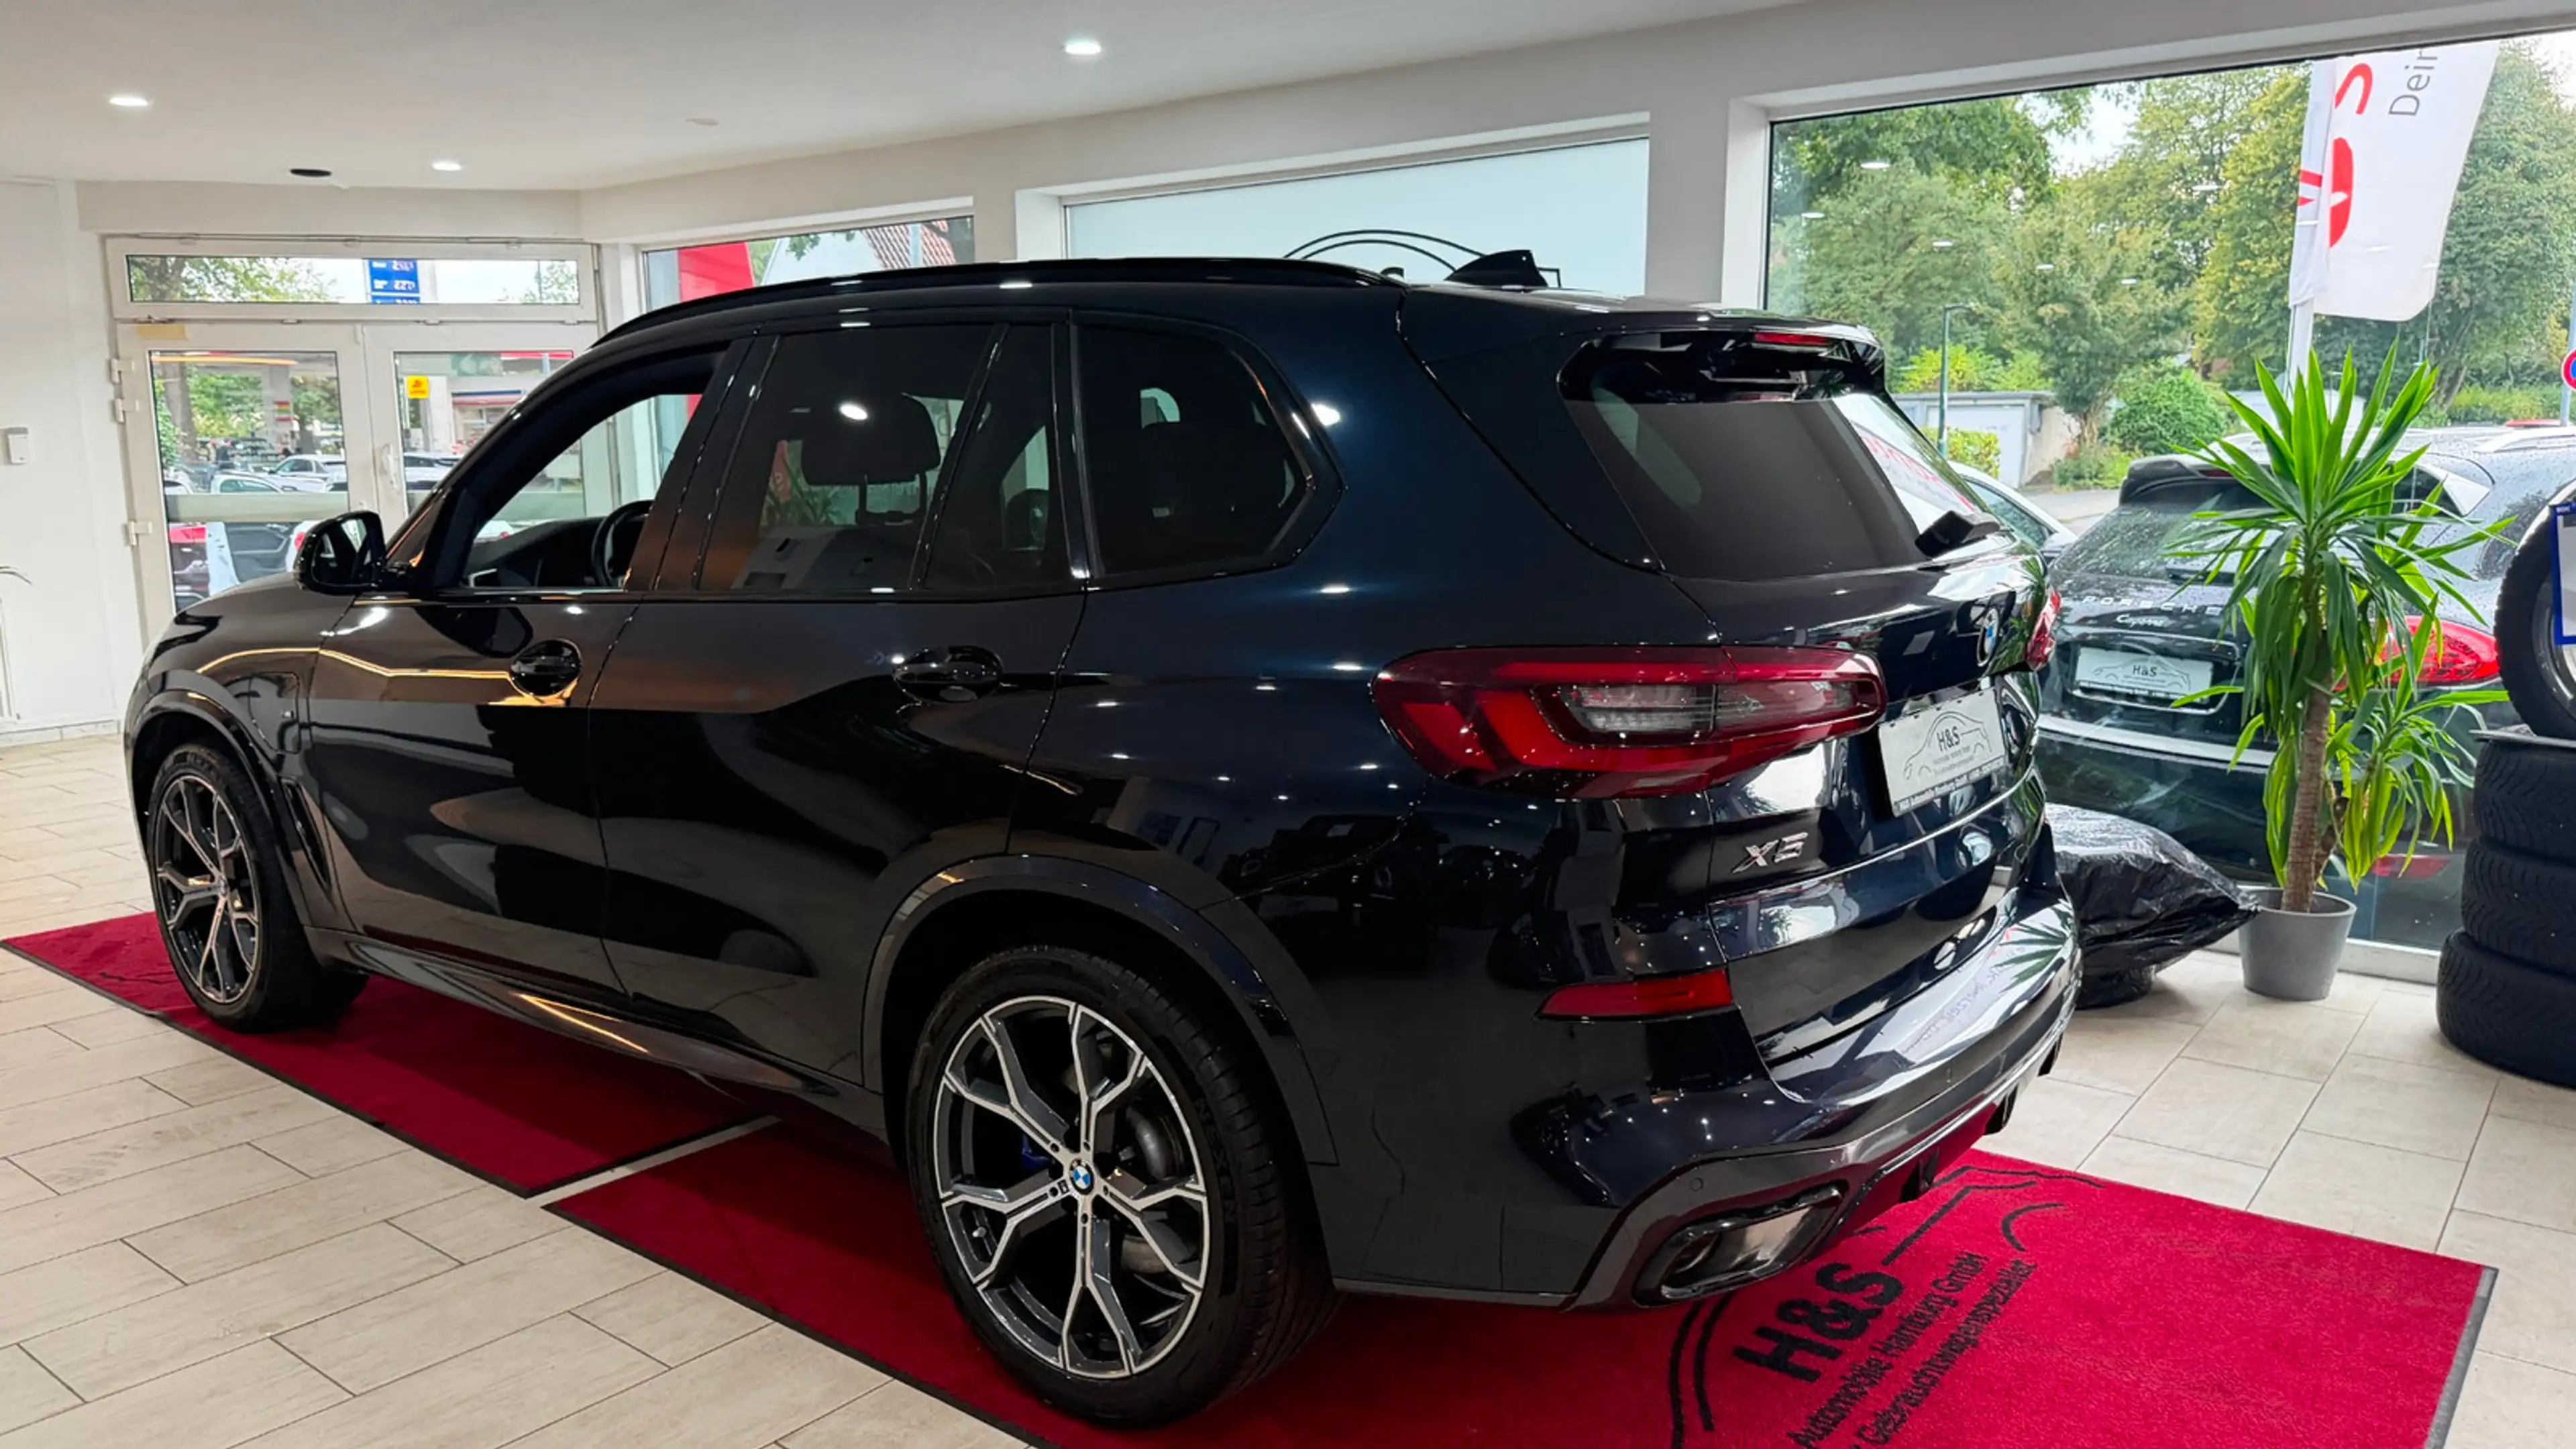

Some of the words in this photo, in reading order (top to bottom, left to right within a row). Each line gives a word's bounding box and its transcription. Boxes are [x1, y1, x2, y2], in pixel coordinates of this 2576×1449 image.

[2082, 595, 2224, 616] PORSCHE
[1936, 727, 1960, 752] H&S
[1731, 832, 1809, 873] X5
[1733, 1263, 1903, 1383] H&S
[1870, 1293, 1958, 1358] Hamburg
[1932, 1252, 1990, 1293] GmbH
